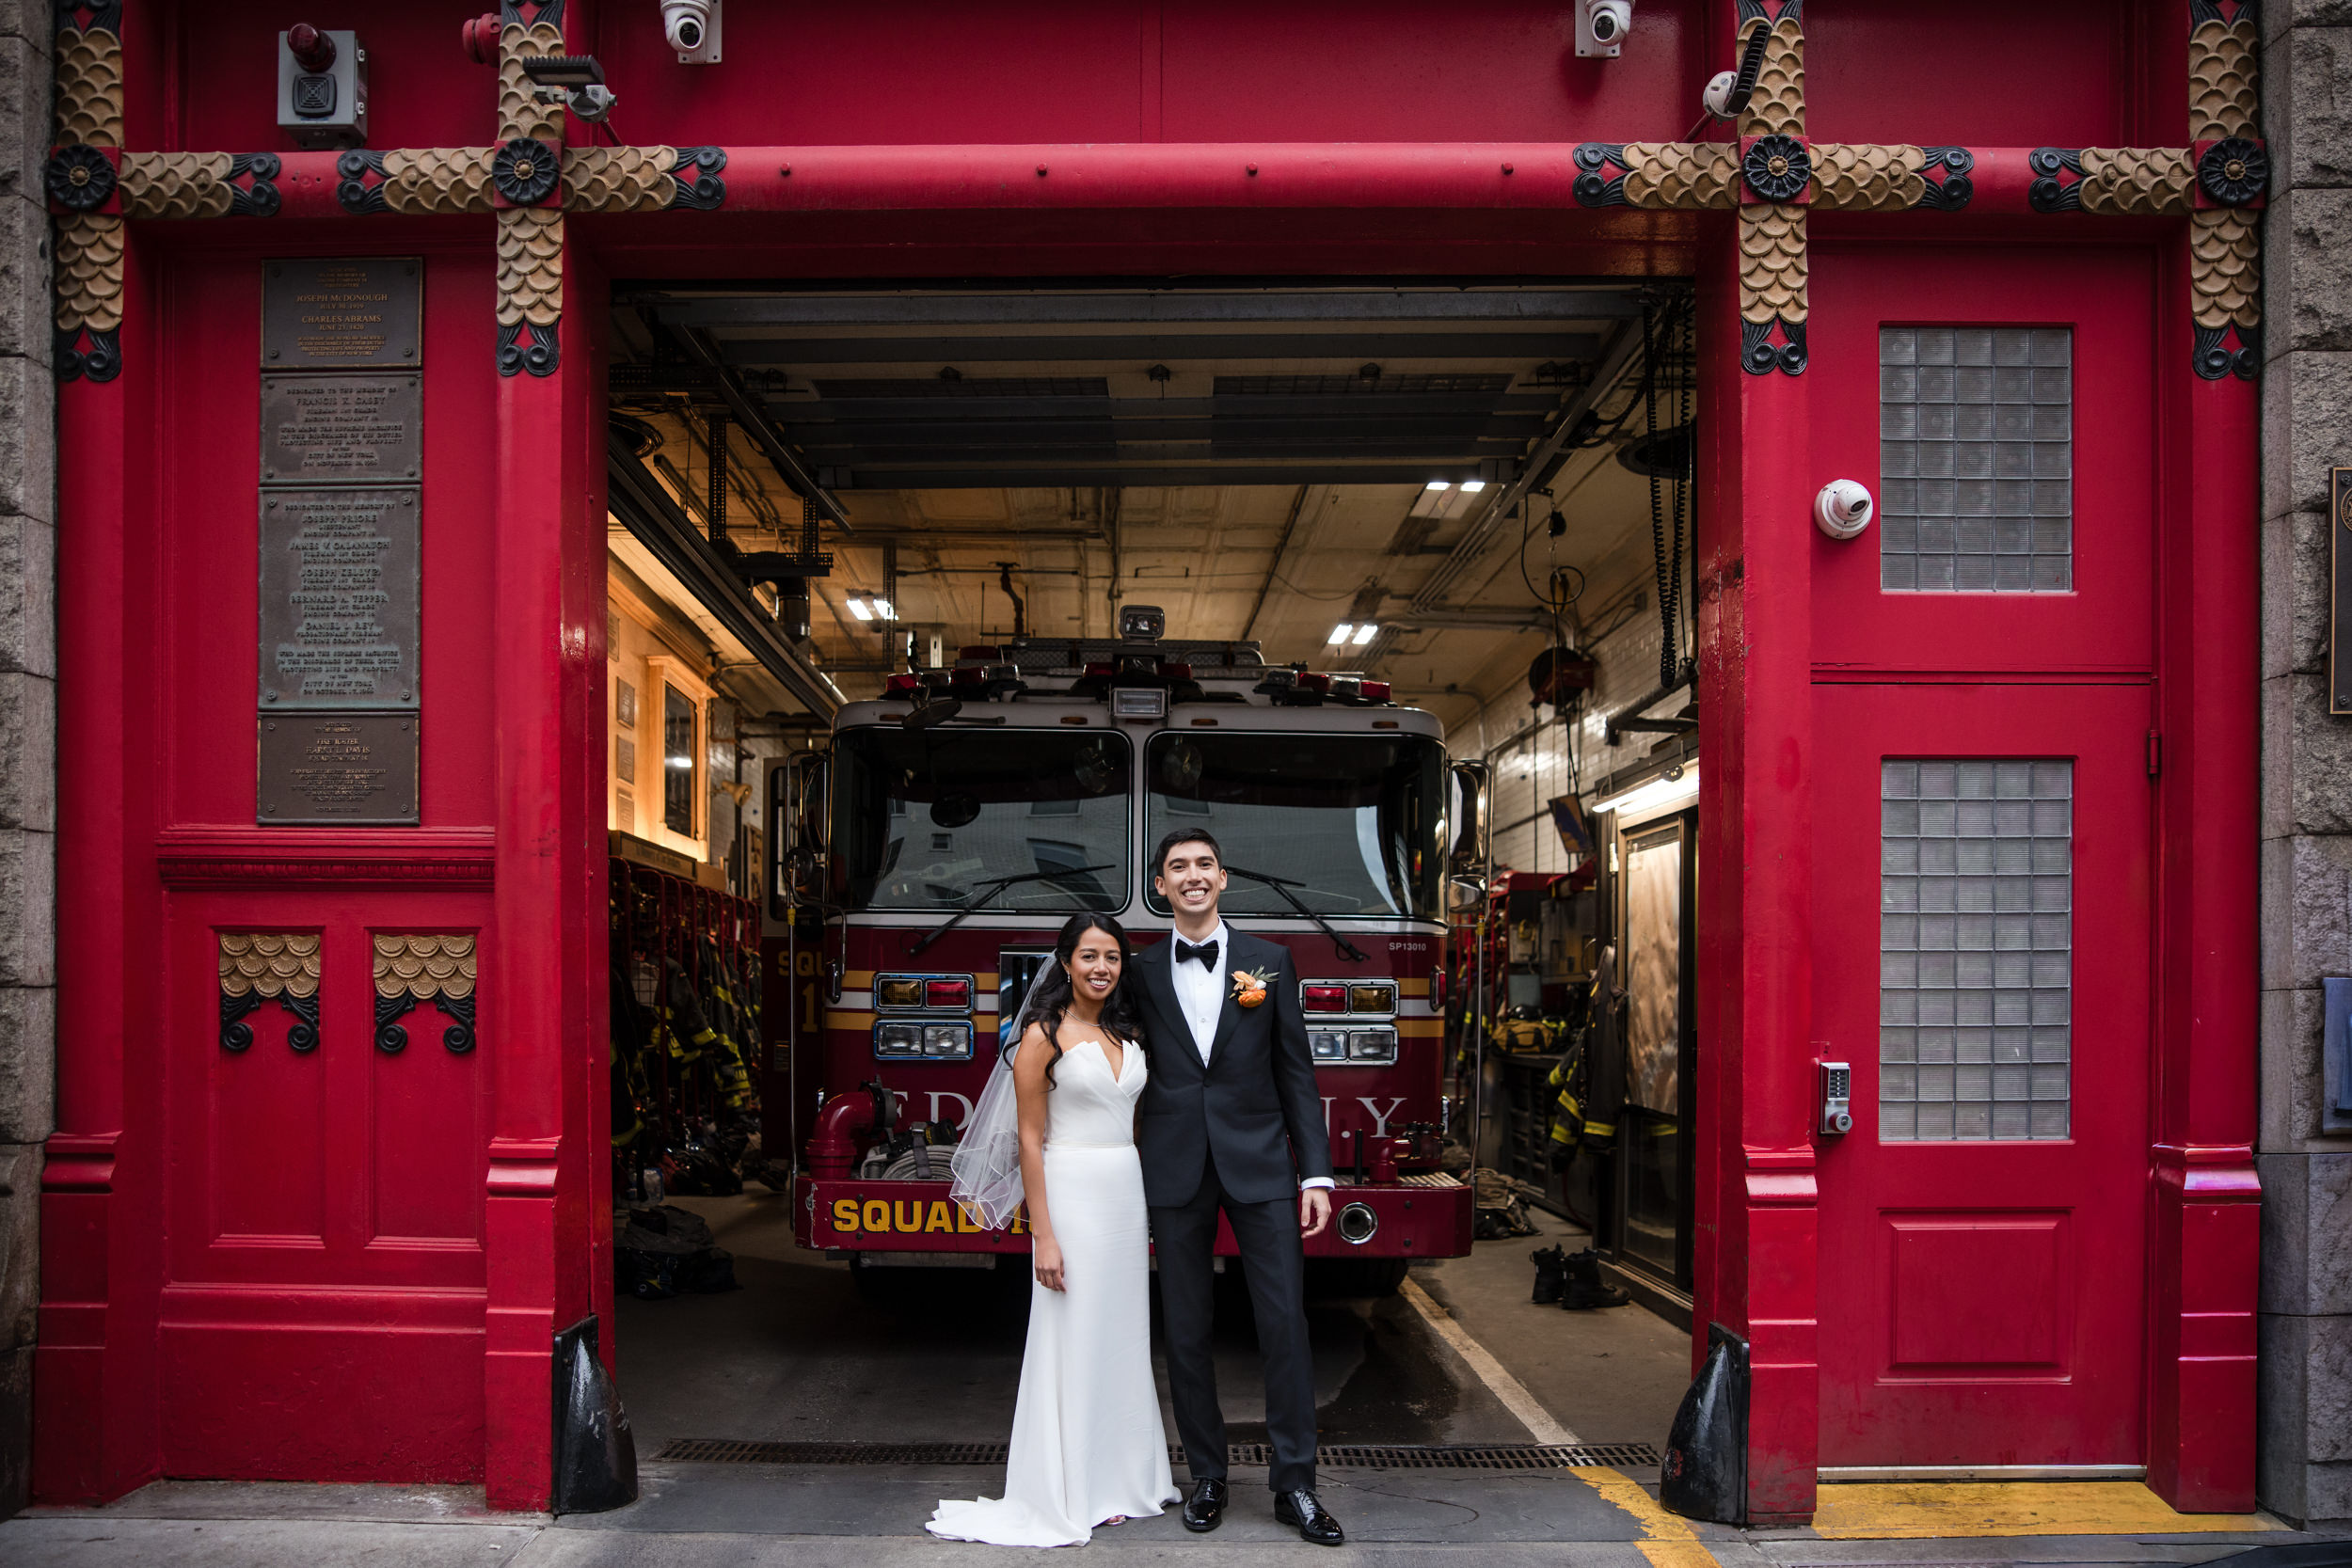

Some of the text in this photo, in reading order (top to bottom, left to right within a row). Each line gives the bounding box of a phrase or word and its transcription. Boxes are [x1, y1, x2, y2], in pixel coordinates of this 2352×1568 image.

[296, 293, 328, 302] JOSEPH
[302, 315, 383, 324] CHARLES ABRAMS
[296, 397, 337, 405] FRANCIS
[302, 515, 377, 523] JOSEPH PRIORE
[290, 542, 319, 550] JAMES
[301, 568, 337, 577] JOSEPH
[292, 594, 337, 603] BERNARD
[352, 594, 388, 603] TEPPER
[305, 622, 340, 630] DANIEL
[1389, 942, 1426, 952] SP13010
[833, 1199, 1031, 1235] SQUAD 1
